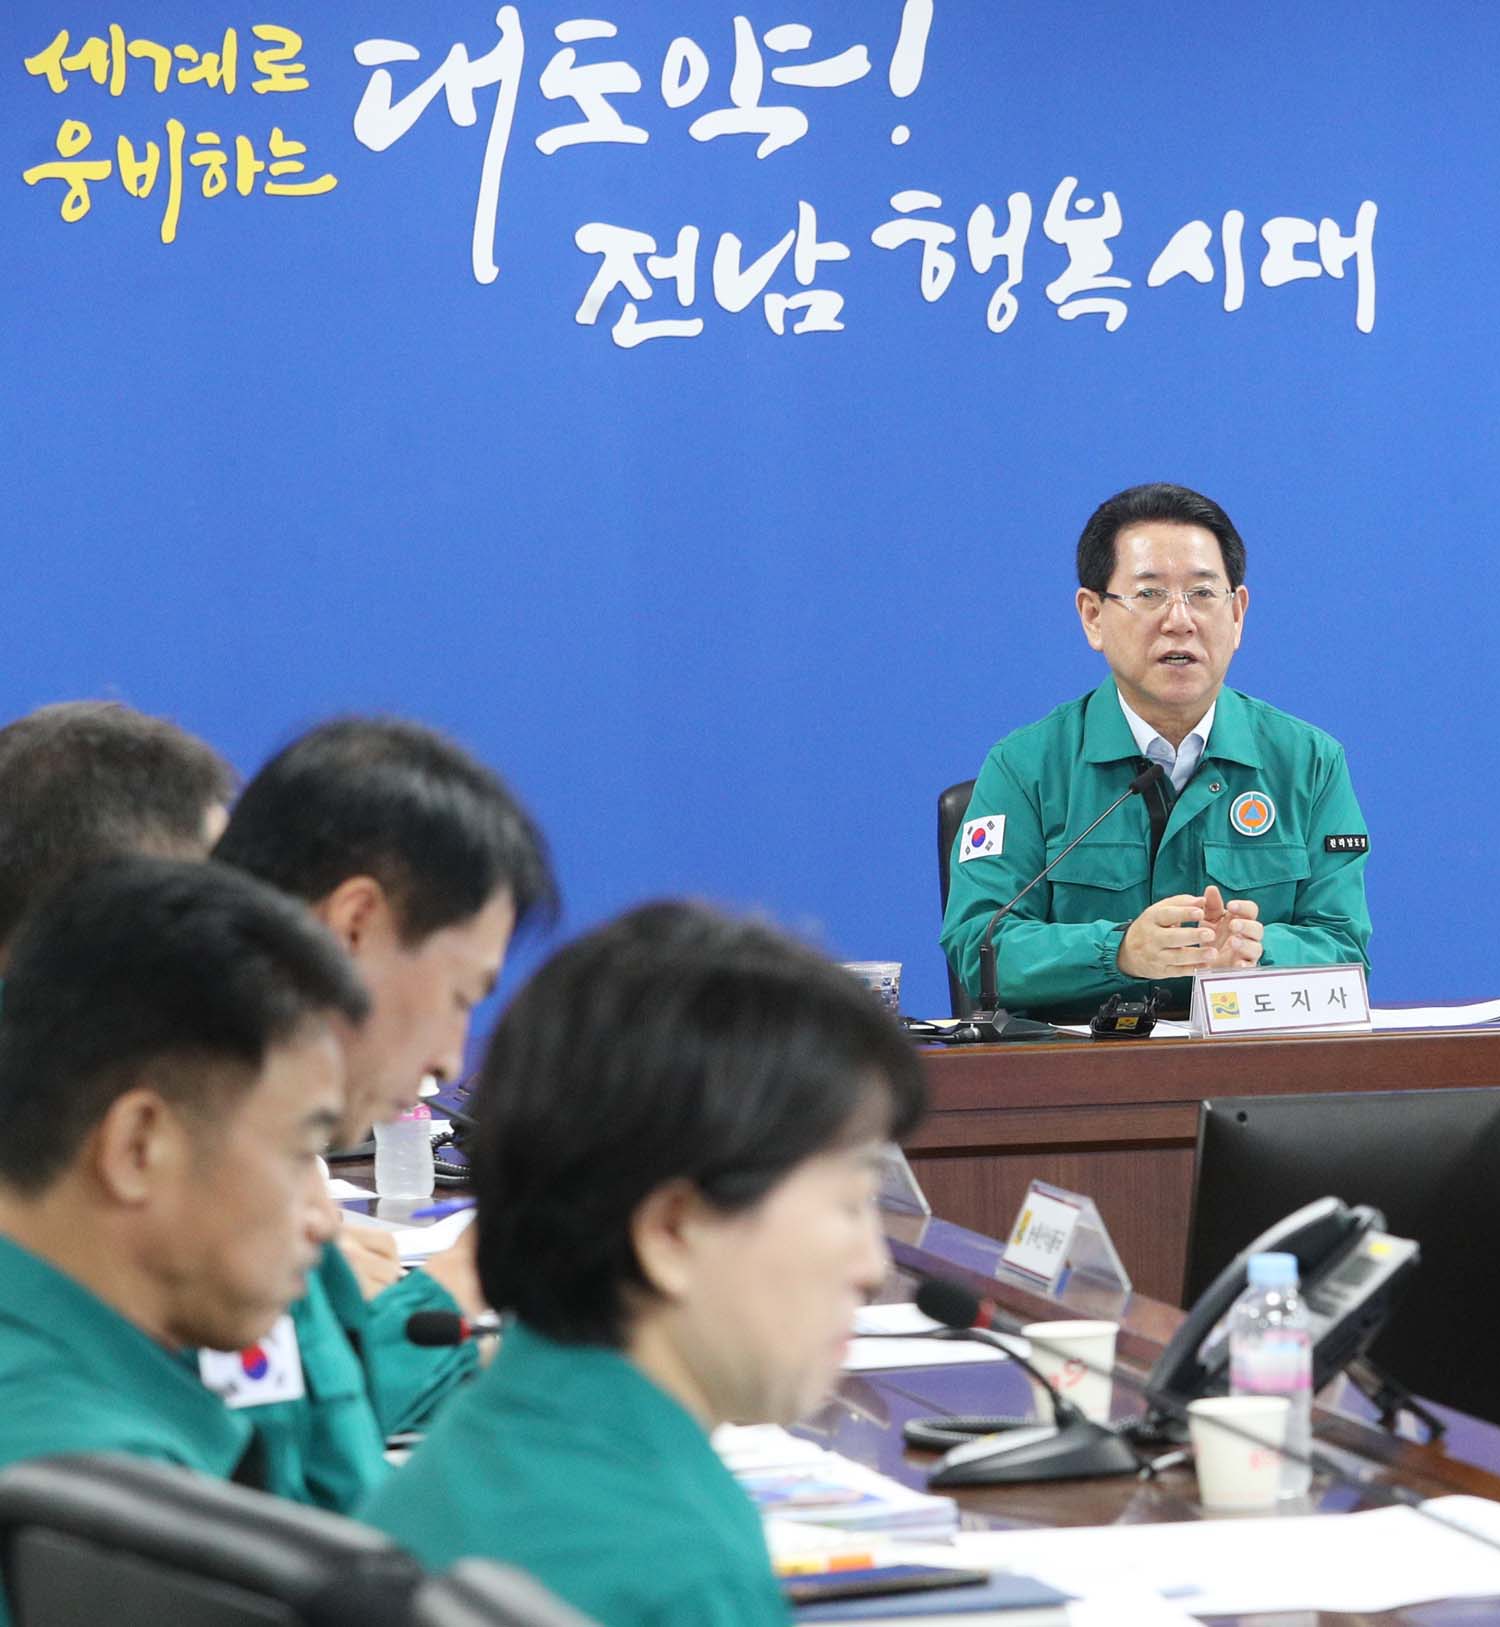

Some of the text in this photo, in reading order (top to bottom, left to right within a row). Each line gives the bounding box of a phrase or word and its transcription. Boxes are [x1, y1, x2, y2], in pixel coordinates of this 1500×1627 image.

[23, 24, 310, 95] 세계로
[22, 118, 338, 244] 웅비하는
[353, 0, 934, 285] 대도약!
[574, 199, 851, 349] 전남
[1253, 986, 1348, 1013] 도지사
